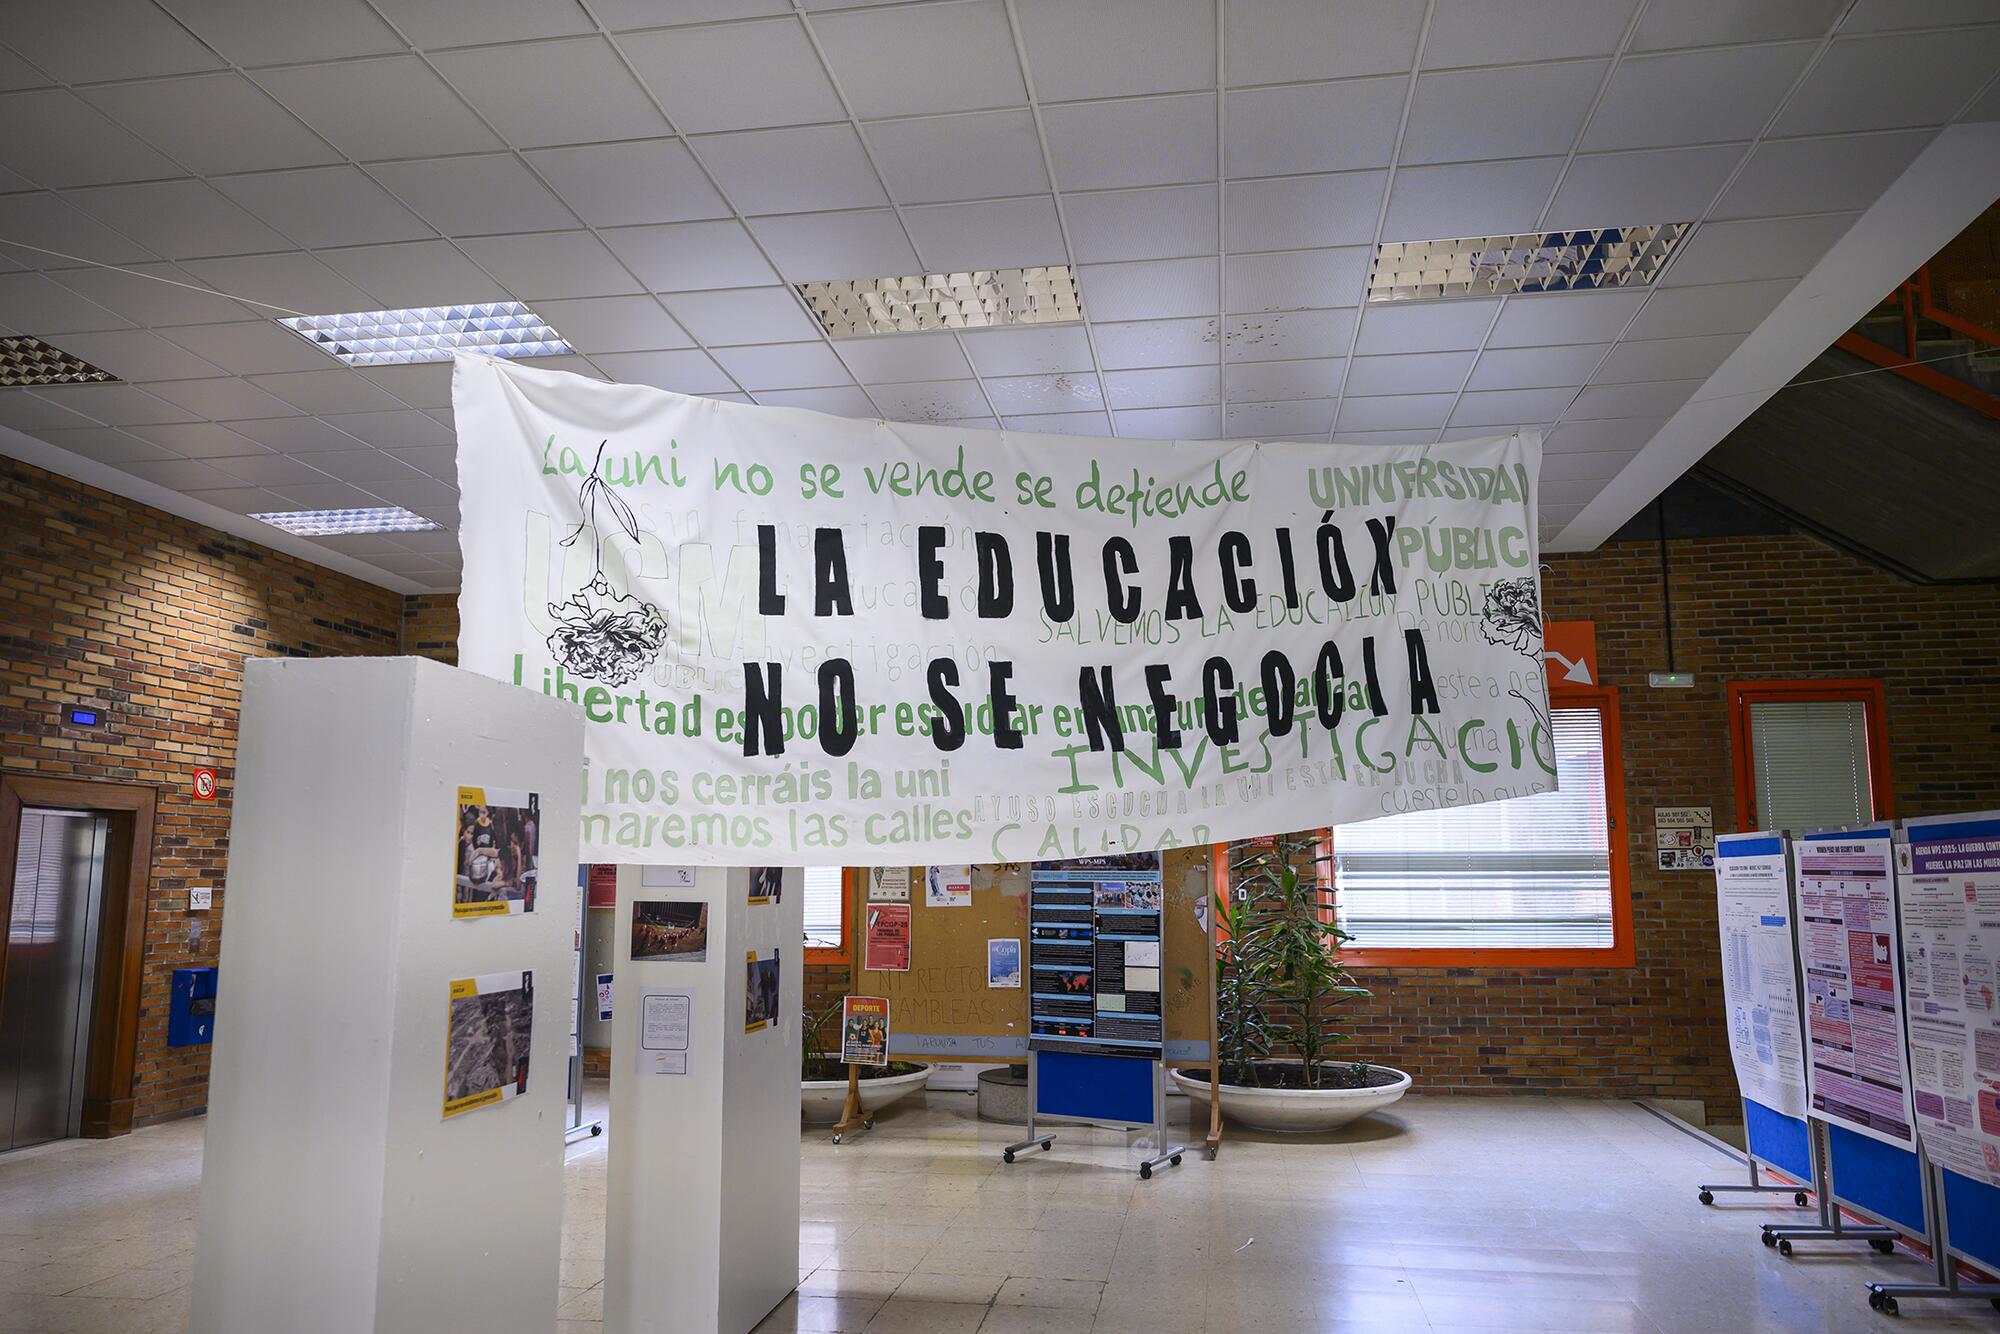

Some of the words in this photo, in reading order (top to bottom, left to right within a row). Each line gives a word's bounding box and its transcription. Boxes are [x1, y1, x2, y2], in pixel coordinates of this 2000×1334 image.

[542, 433, 587, 477] La
[602, 438, 687, 488] uni
[714, 456, 775, 497] no
[800, 462, 845, 500] se
[863, 445, 996, 503] vende
[1015, 469, 1056, 509] se
[1075, 459, 1251, 529] defiende
[756, 524, 855, 617] LA
[1395, 515, 1530, 573] PÚBLIC
[1038, 605, 1181, 646] SALVEMOS
[1200, 604, 1235, 638] LA
[742, 657, 858, 758] NO
[926, 657, 1024, 752] SE
[1079, 629, 1441, 752] NEGOCIA
[1231, 680, 1271, 722] de
[604, 767, 680, 806] nos
[691, 762, 833, 807] cerráis
[847, 761, 883, 802] la
[894, 758, 953, 801] uni
[972, 794, 1057, 824] AYUSO
[1072, 789, 1189, 820] ESCUCHA
[1394, 758, 1465, 787] LUCHA
[579, 811, 774, 849] maremos
[789, 808, 851, 852] las
[864, 803, 974, 846] calles
[852, 1004, 881, 1013] DEPORTE
